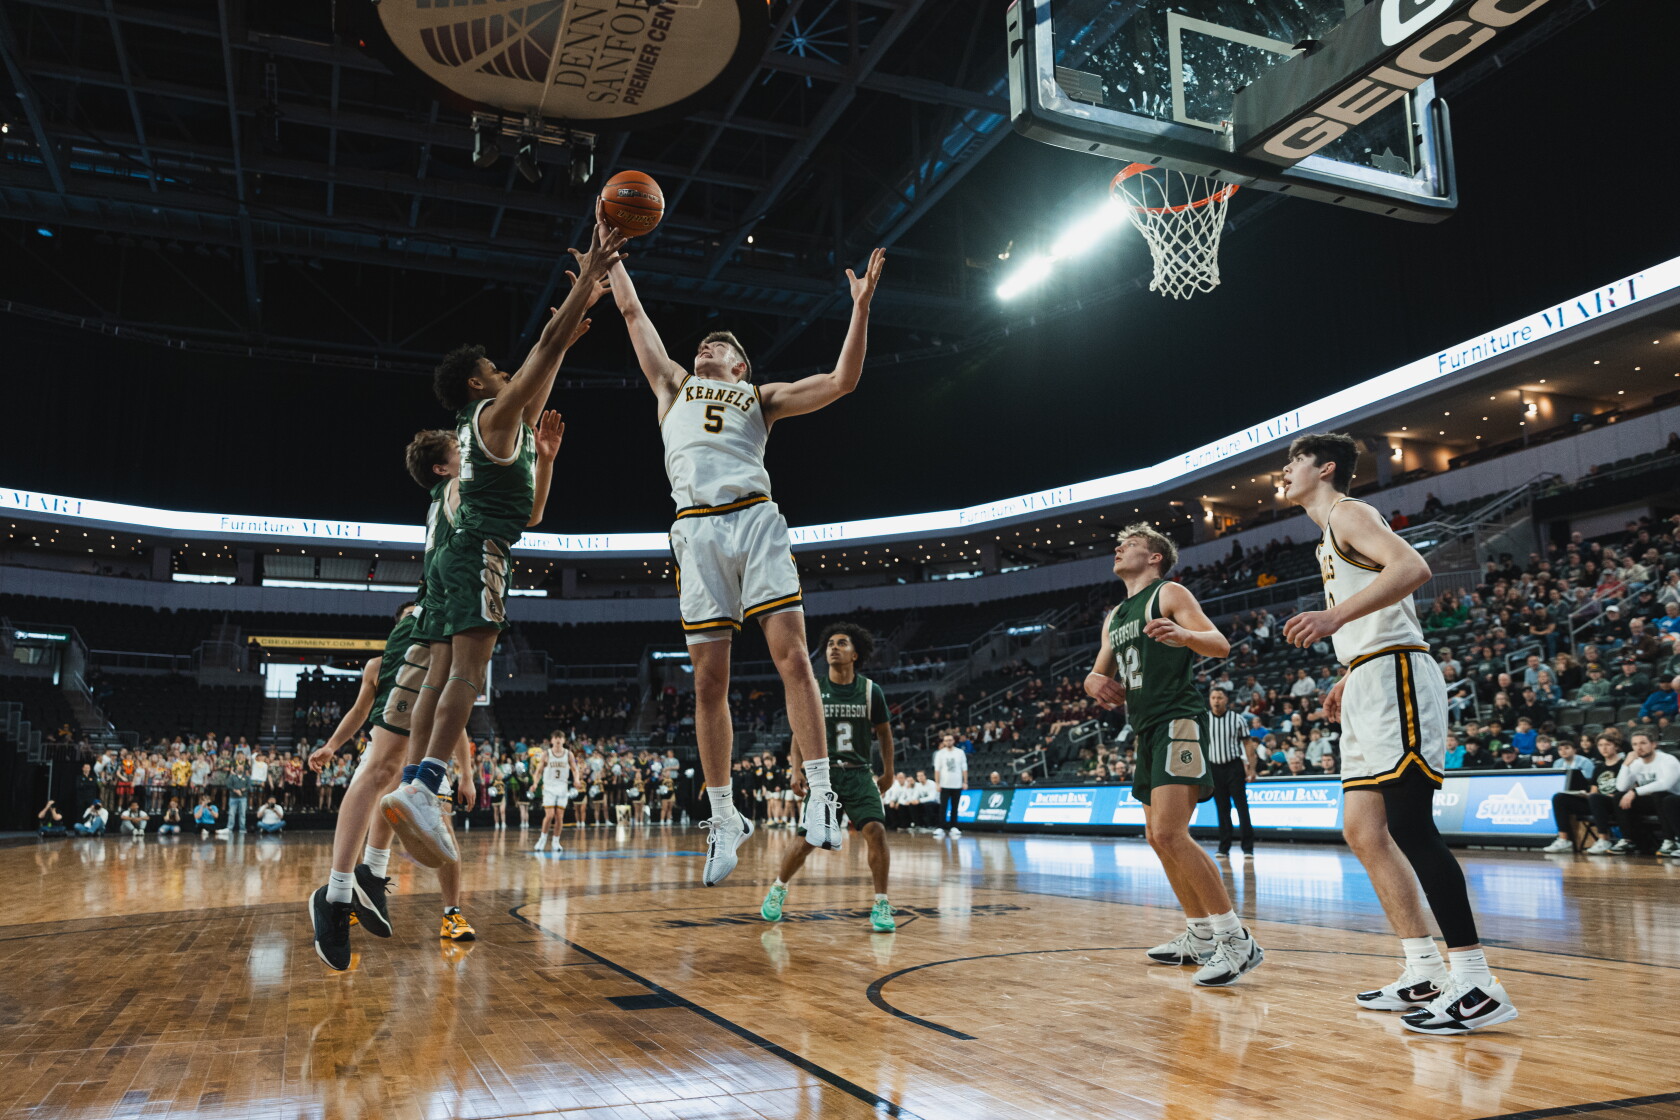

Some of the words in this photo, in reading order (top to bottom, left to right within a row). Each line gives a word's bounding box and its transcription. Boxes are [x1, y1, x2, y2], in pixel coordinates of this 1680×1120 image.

[622, 43, 662, 105] PREMIER
[1437, 324, 1533, 374] Furniture
[1541, 274, 1645, 329] MART
[685, 385, 755, 412] KERNELS
[704, 404, 726, 434] 5
[1184, 439, 1241, 471] Furniture
[220, 516, 295, 534] Furniture
[823, 704, 867, 718] EFFERSON
[835, 721, 855, 752] 2
[1246, 789, 1294, 801] DACOTAH
[1294, 787, 1329, 800] BANK
[1480, 802, 1547, 816] SUMMIT
